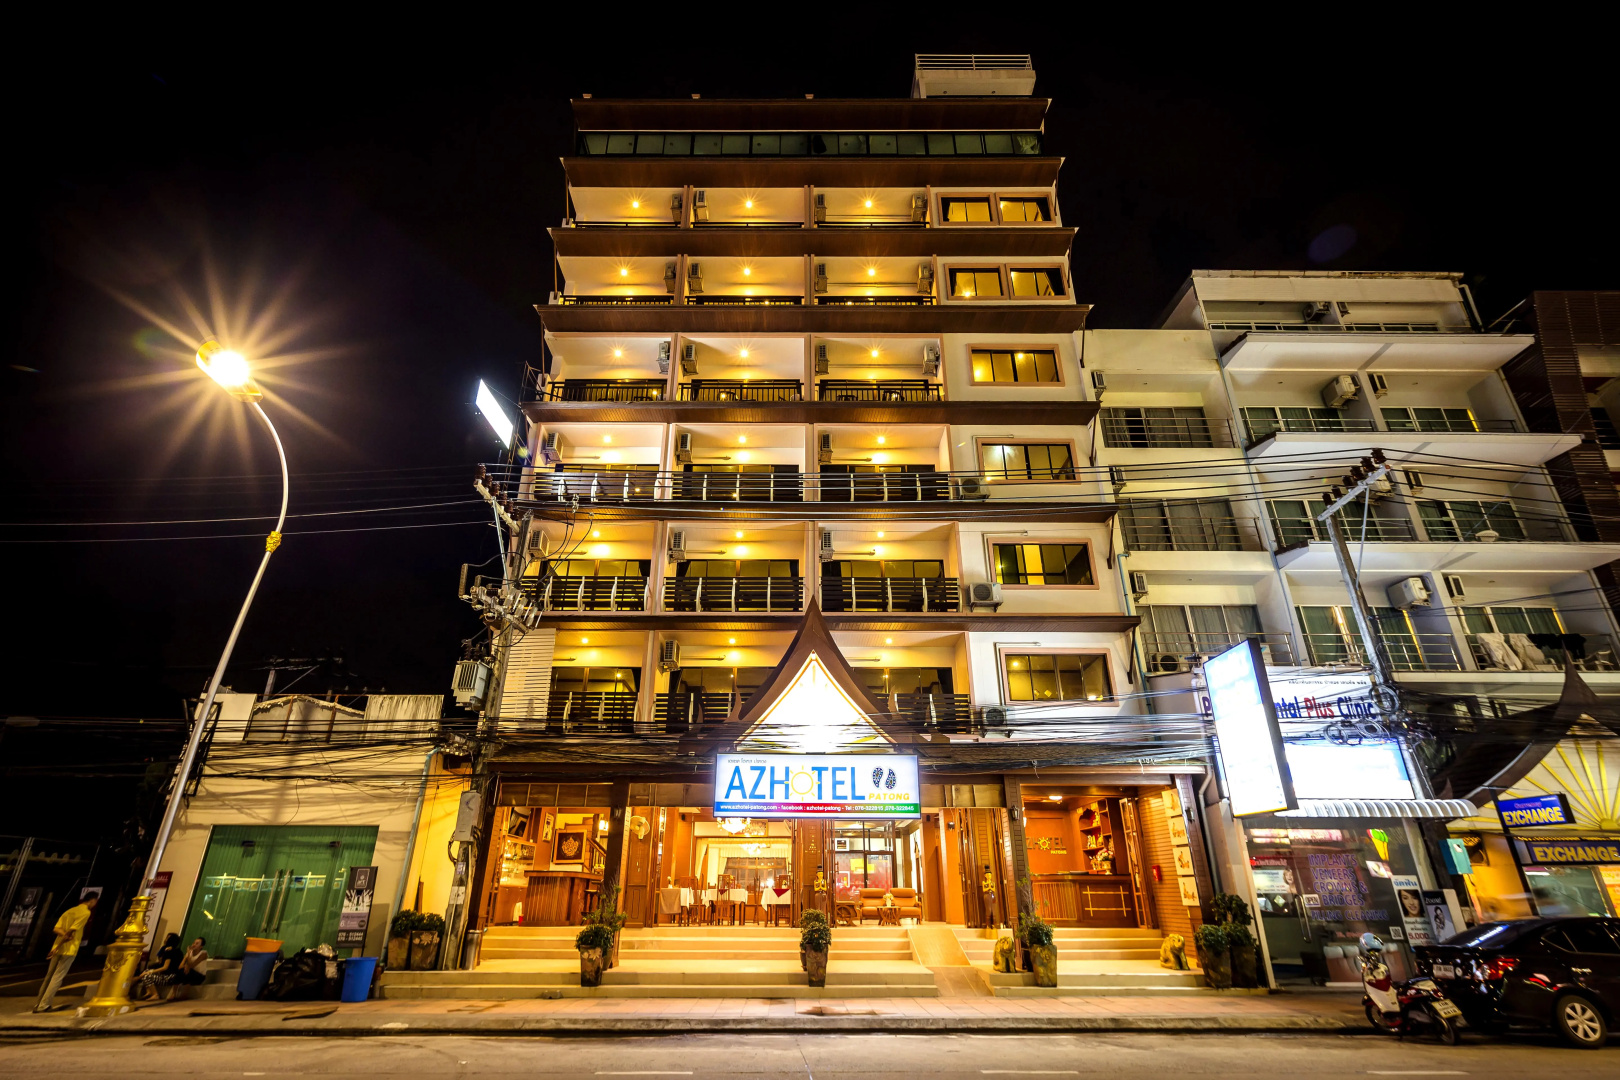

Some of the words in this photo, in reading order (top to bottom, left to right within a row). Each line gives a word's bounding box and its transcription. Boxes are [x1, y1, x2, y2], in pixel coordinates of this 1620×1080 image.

[1274, 695, 1302, 718] ntal
[1303, 695, 1335, 719] Plus
[1336, 696, 1377, 720] Clinic
[724, 765, 866, 801] AZHOTEL
[868, 792, 910, 800] PATONG
[1501, 806, 1565, 826] EXCHANGE
[1307, 853, 1358, 867] IMPLANTS
[1532, 846, 1620, 862] EXCHANGE
[1310, 867, 1357, 881] VENEERS
[1312, 881, 1358, 894] CROWNS
[1358, 881, 1369, 894] &
[1304, 896, 1319, 904] OPEN
[1321, 893, 1366, 907] BRIDGES
[1344, 909, 1390, 920] CLEANING
